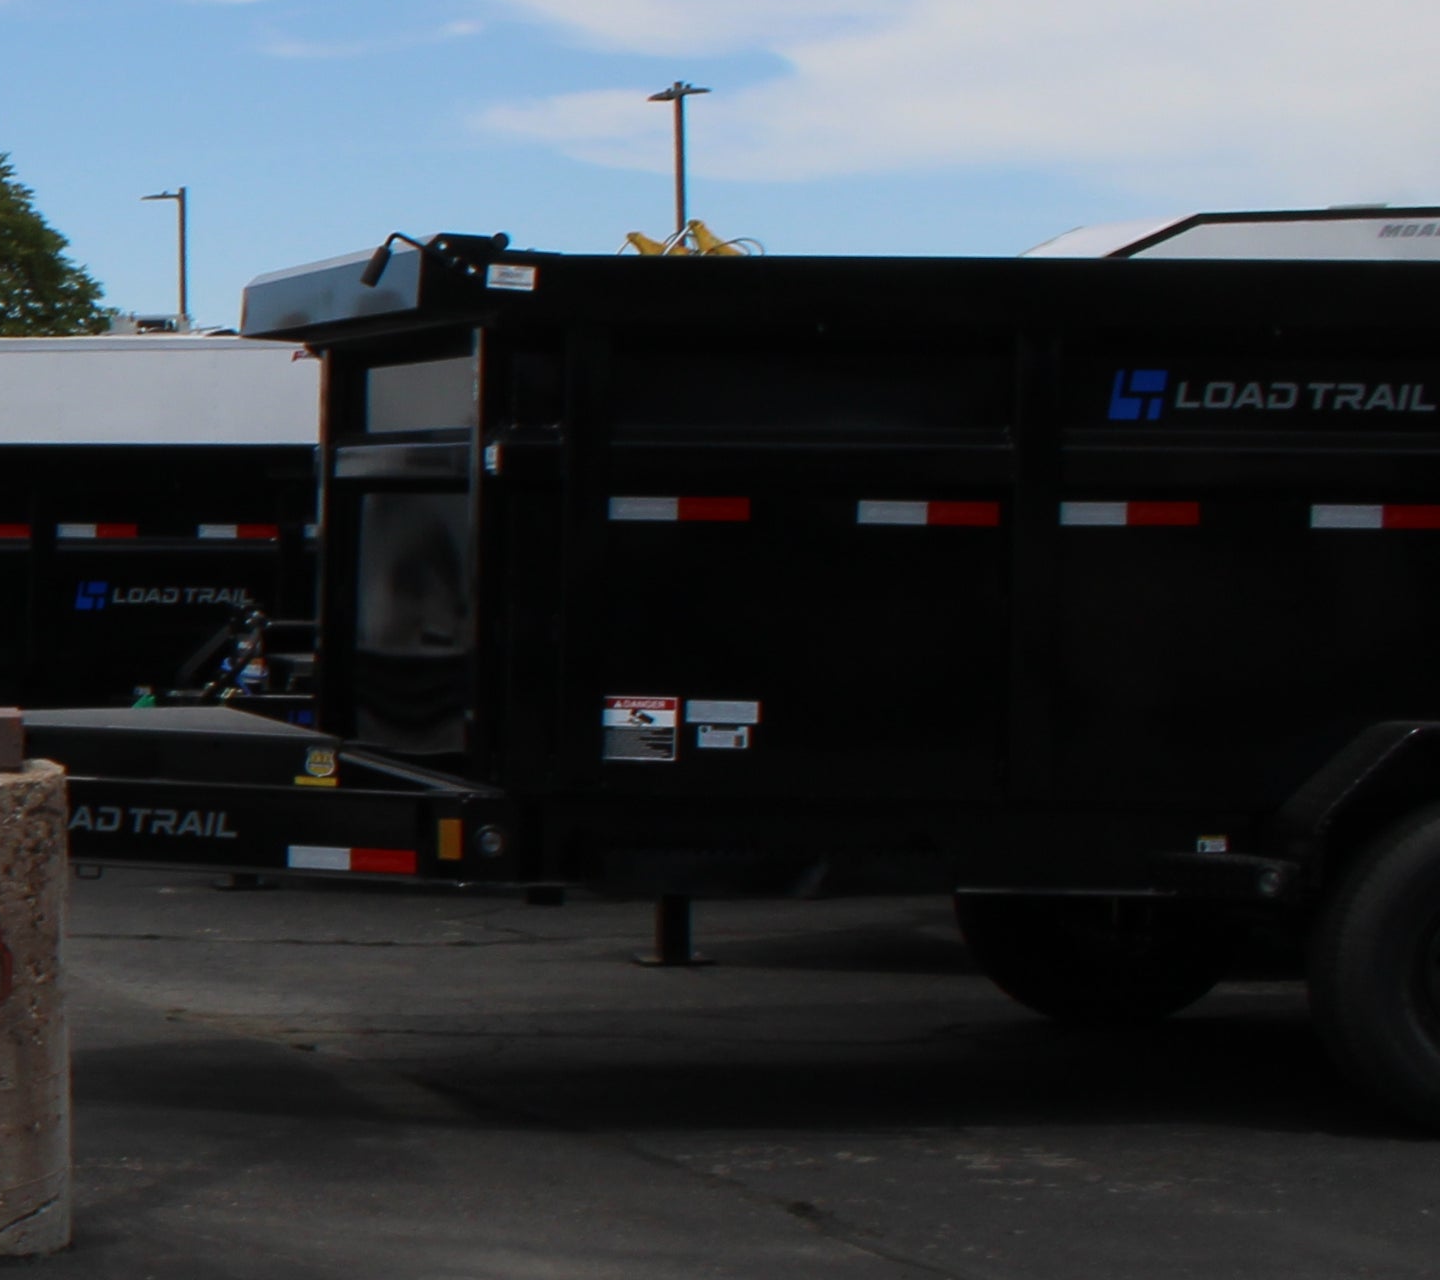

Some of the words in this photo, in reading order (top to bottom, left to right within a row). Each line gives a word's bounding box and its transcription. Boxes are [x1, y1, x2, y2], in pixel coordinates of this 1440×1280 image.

[1174, 381, 1298, 409] LOAD
[1306, 382, 1437, 411] TRAIL
[111, 586, 180, 605] LOAD
[183, 586, 256, 606] TRAIL
[68, 805, 124, 833] AD
[127, 806, 239, 839] TRAIL
